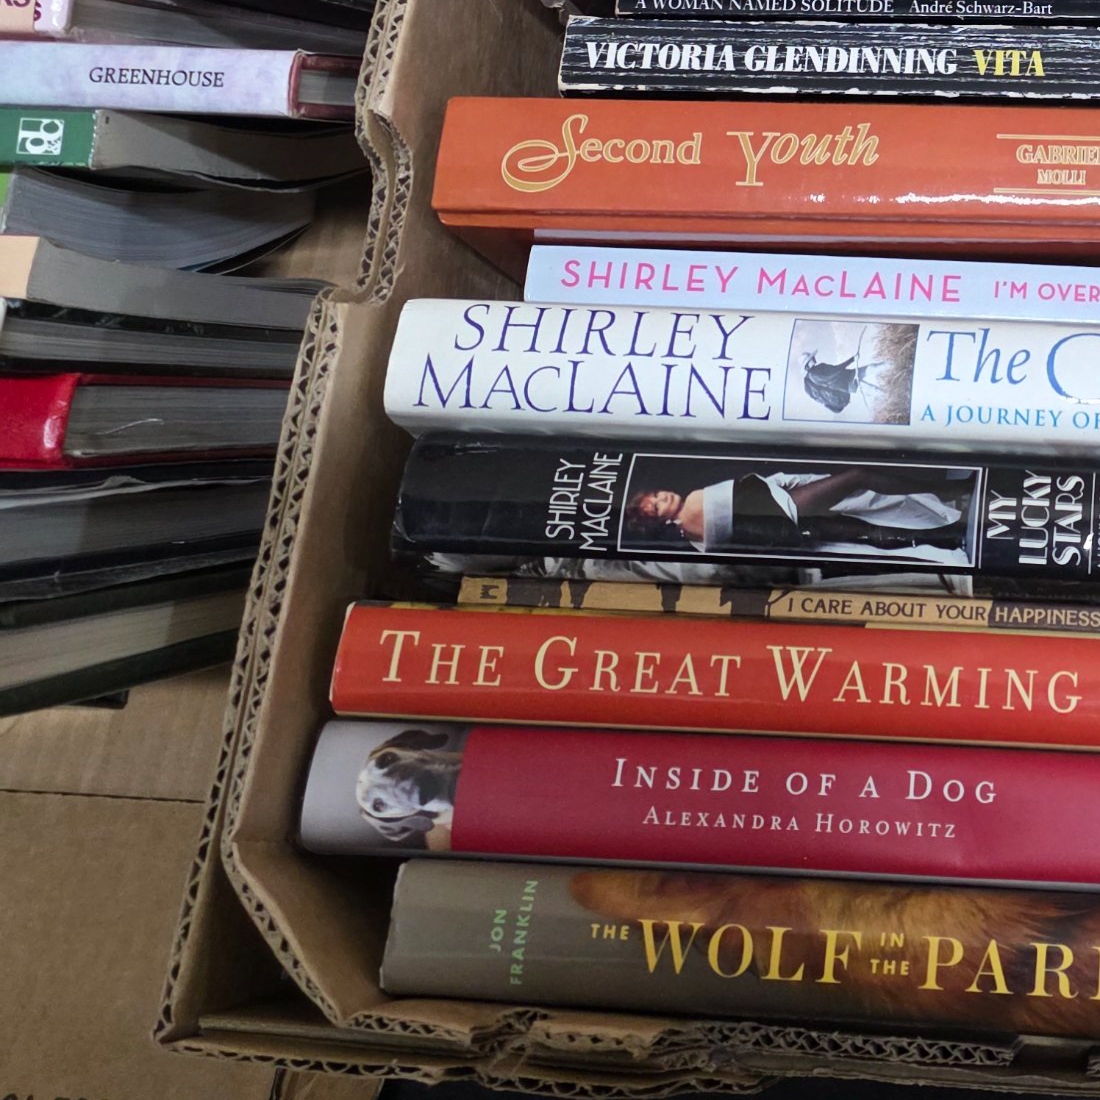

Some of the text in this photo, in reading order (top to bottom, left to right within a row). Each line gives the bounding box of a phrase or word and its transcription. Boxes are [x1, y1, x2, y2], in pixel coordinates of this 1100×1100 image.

[89, 67, 225, 88] GREENHOUSE
[585, 41, 1046, 77] VICTORIA GLENDINNING VITA
[501, 113, 880, 192] Second Youth
[561, 259, 739, 294] SHIRLEY
[994, 280, 1028, 300] I'M
[1038, 282, 1100, 303] OVER
[453, 303, 756, 361] SHIRLEY
[927, 328, 1031, 385] The
[921, 404, 937, 422] A
[945, 405, 1063, 428] JOURNEY
[545, 459, 586, 541] SHIRLEY
[579, 452, 623, 552] MACLAINE
[986, 491, 1018, 540] MY
[1018, 470, 1052, 565] LUCKY
[1052, 475, 1085, 567] STARS
[787, 598, 792, 613] I
[801, 598, 853, 615] CARE
[860, 601, 929, 621] ABOUT
[935, 604, 987, 622] YOUR
[380, 627, 1083, 714] THE GREAT WARMING
[611, 757, 997, 804] INSIDE OF A DOG
[643, 806, 956, 838] ALEXANDRA HOROWITZ
[490, 908, 507, 952] JON
[509, 880, 539, 985] FRANKLIN
[590, 923, 630, 941] THE
[637, 919, 862, 984] WOLF
[880, 932, 904, 948] IN
[870, 958, 910, 976] THE
